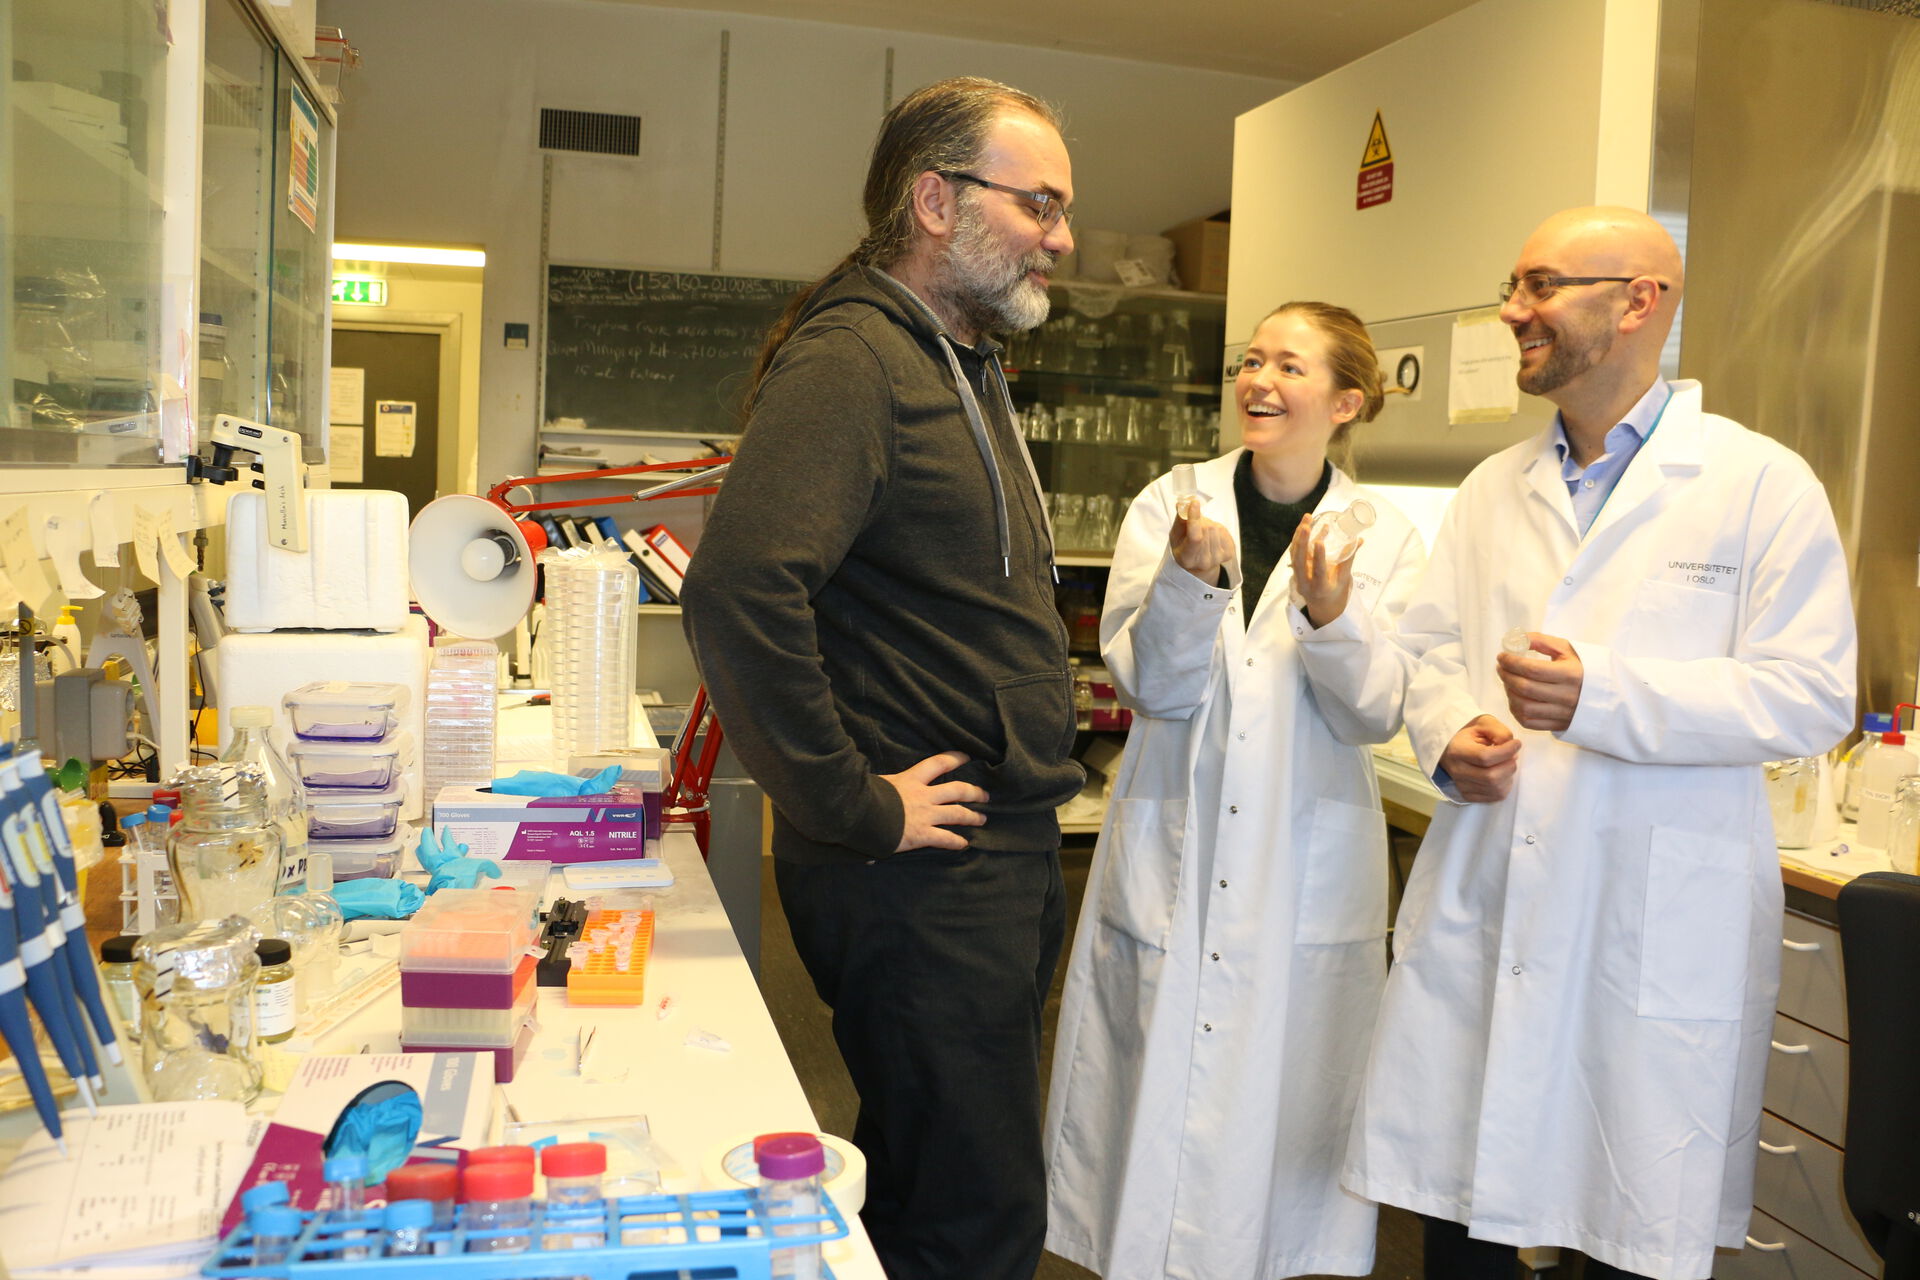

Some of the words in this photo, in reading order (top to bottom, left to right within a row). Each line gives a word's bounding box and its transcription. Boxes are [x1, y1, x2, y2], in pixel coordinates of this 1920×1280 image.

[1668, 560, 1738, 575] UNIVERSITETET
[1692, 575, 1716, 584] OSLO
[608, 831, 637, 839] NITRILE
